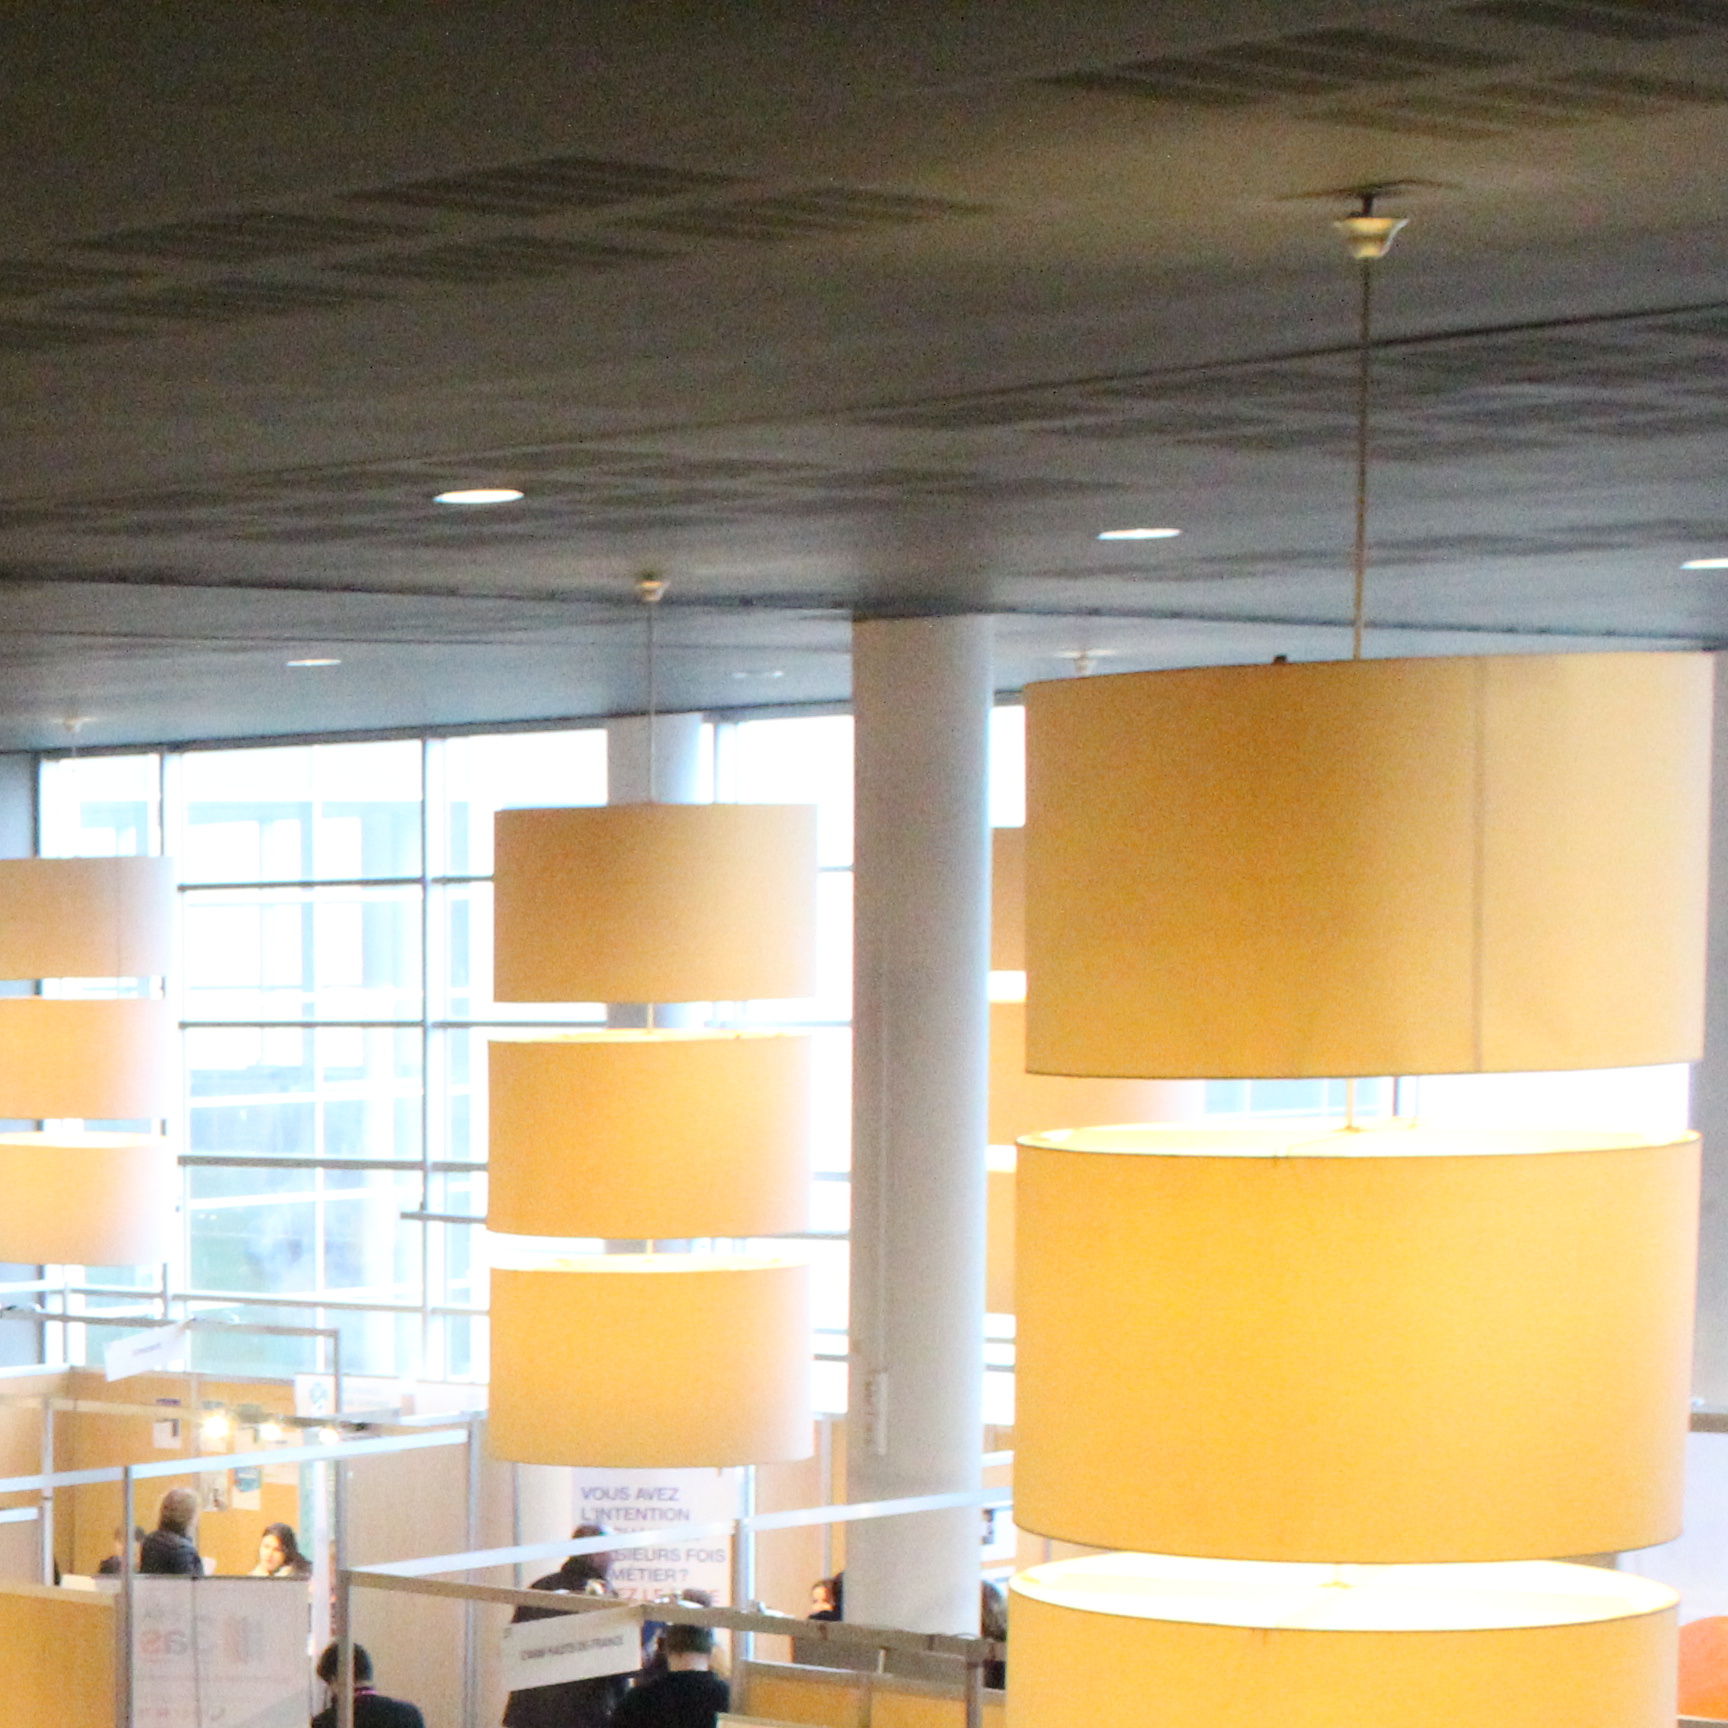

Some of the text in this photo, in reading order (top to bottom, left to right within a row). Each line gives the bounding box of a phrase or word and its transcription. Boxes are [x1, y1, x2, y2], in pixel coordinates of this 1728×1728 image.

[581, 1487, 680, 1501] VOUS AVEZ
[581, 1507, 690, 1521] L'INTENTION
[686, 1550, 726, 1562] FOIS
